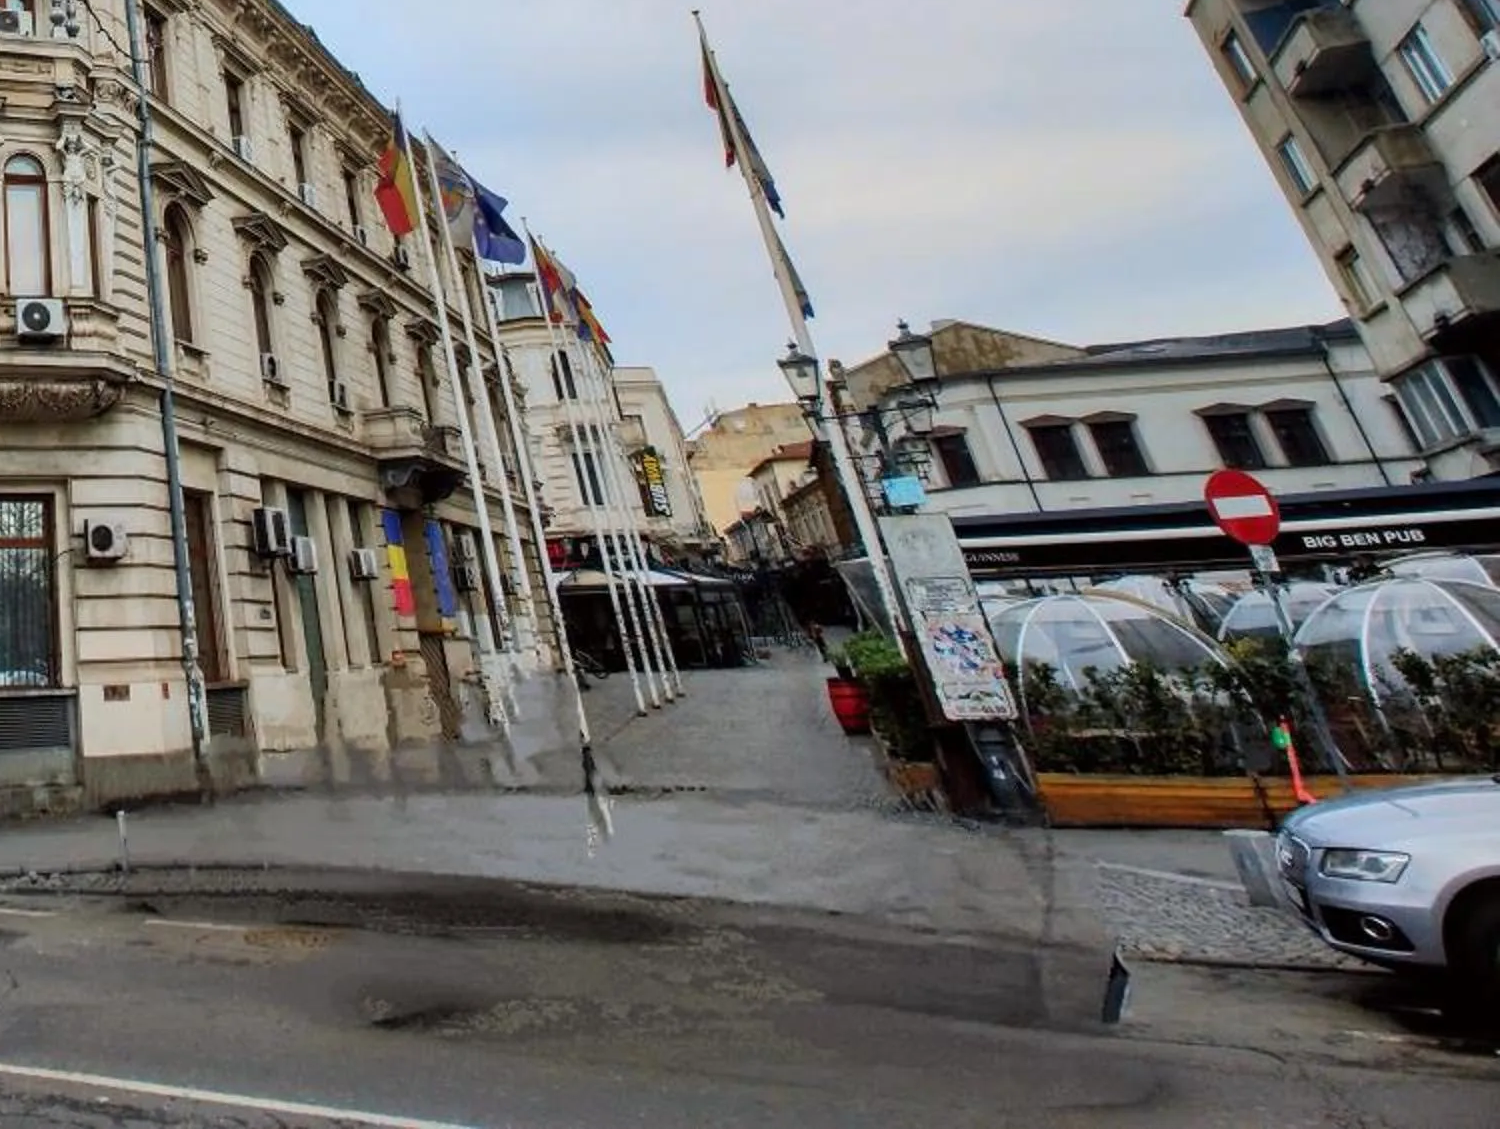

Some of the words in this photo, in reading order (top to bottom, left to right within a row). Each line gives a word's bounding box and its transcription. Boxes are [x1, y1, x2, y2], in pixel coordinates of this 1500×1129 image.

[643, 454, 671, 516] SUBWAY
[1302, 536, 1338, 549] BIG
[1340, 532, 1381, 547] BEN
[1383, 529, 1426, 543] PUB
